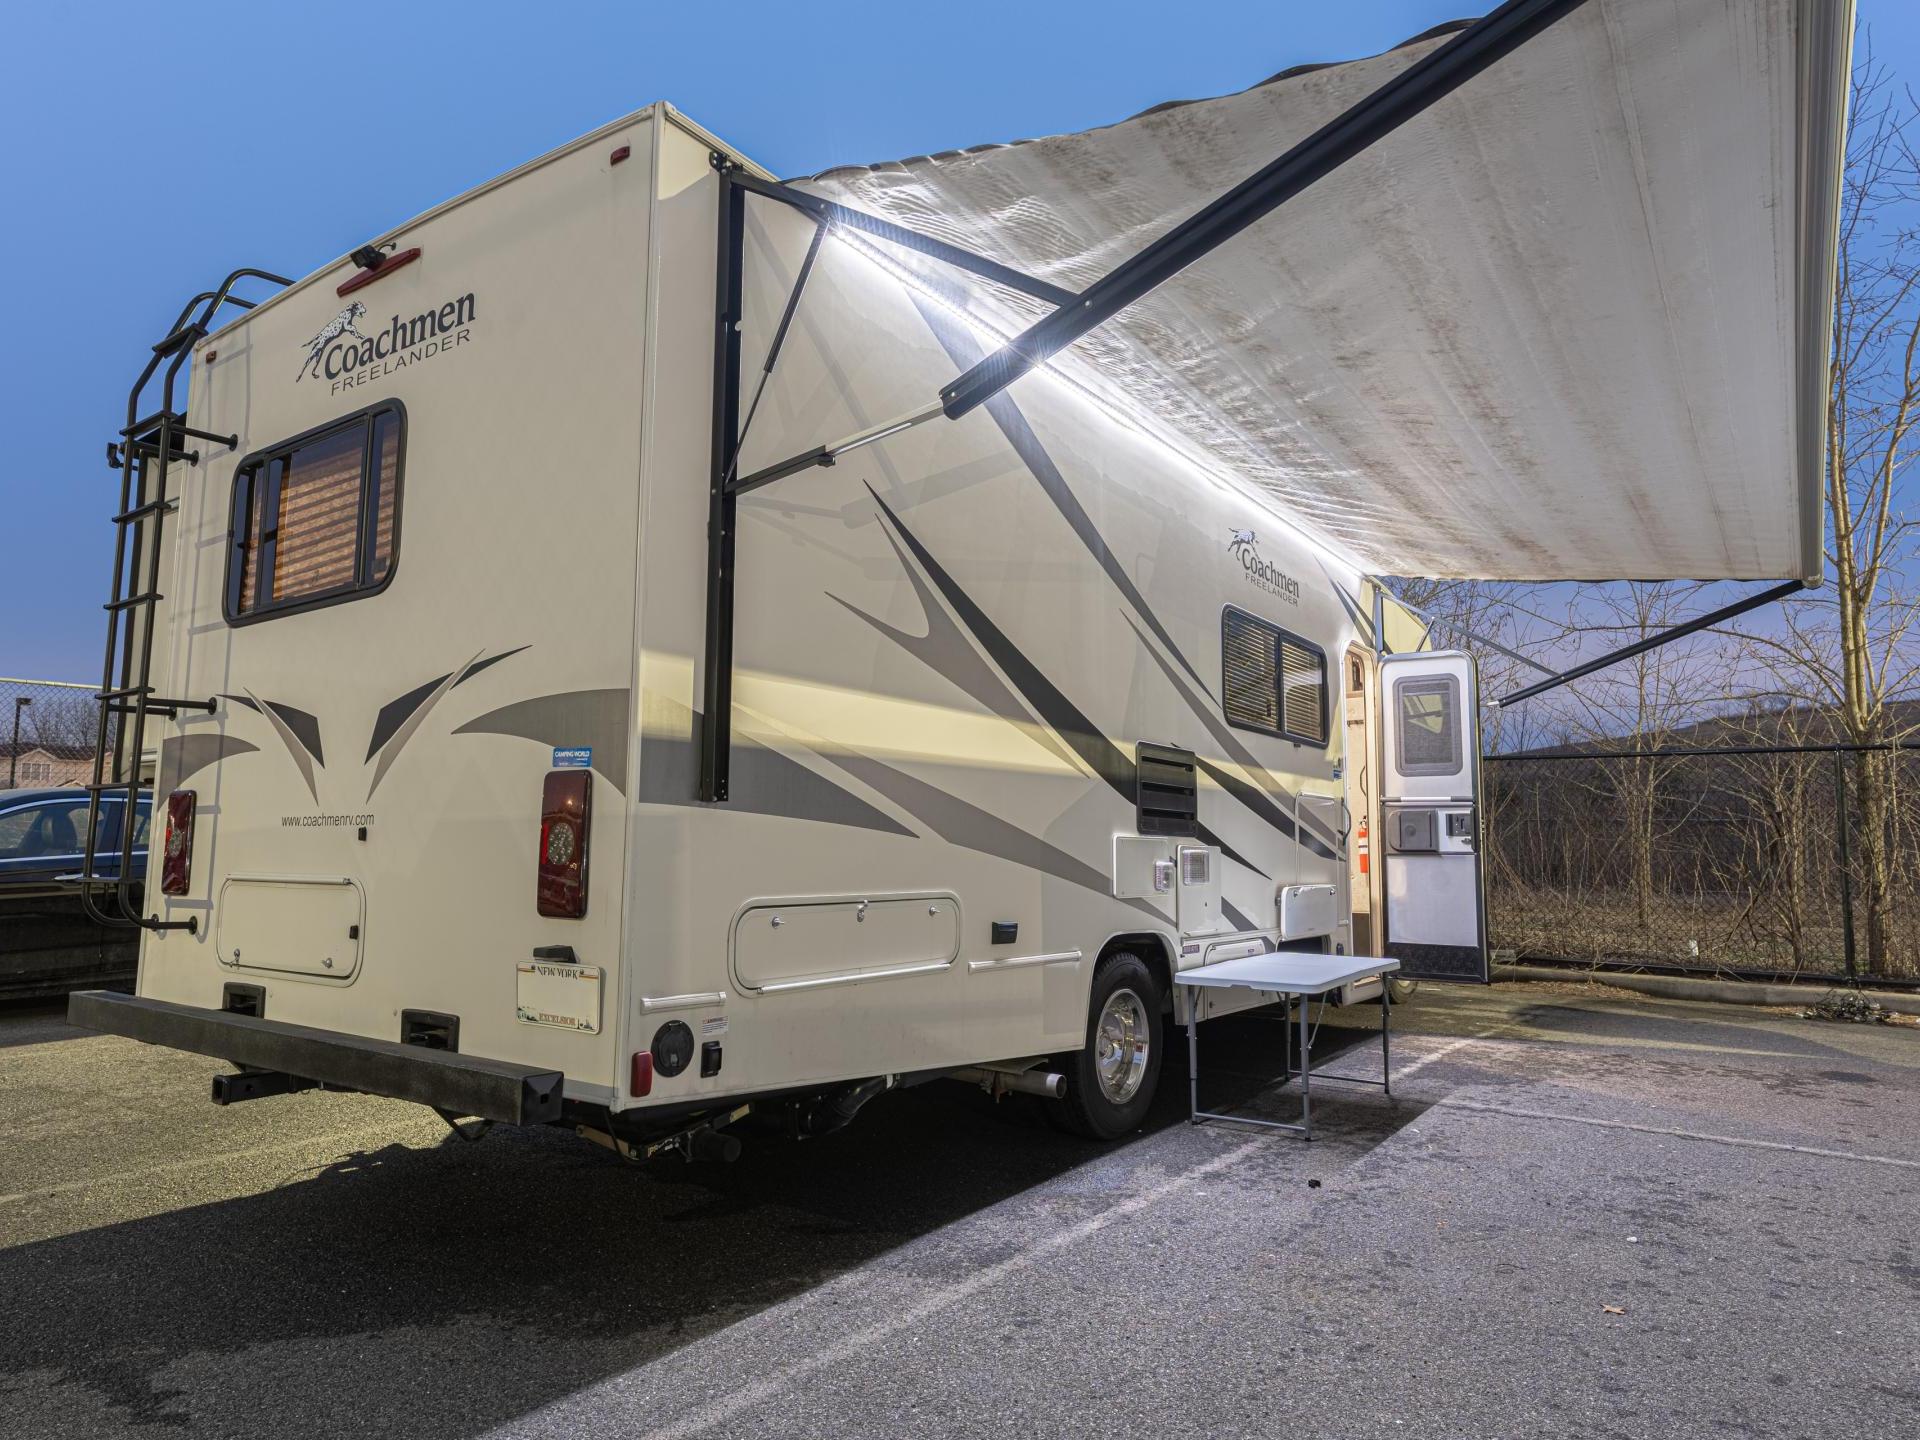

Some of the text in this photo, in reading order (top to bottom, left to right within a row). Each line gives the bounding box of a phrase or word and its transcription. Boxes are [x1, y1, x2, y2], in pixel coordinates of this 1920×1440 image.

[324, 292, 476, 380] Coachmen
[331, 328, 471, 396] FREELANDER
[1242, 548, 1300, 598] Coachmen
[1245, 572, 1298, 607] FREELANDER
[574, 750, 590, 758] WORLD
[281, 812, 375, 827] www.coachmenrv.com
[537, 966, 578, 980] NEW YORK
[539, 1012, 576, 1025] EXCELSIOR
